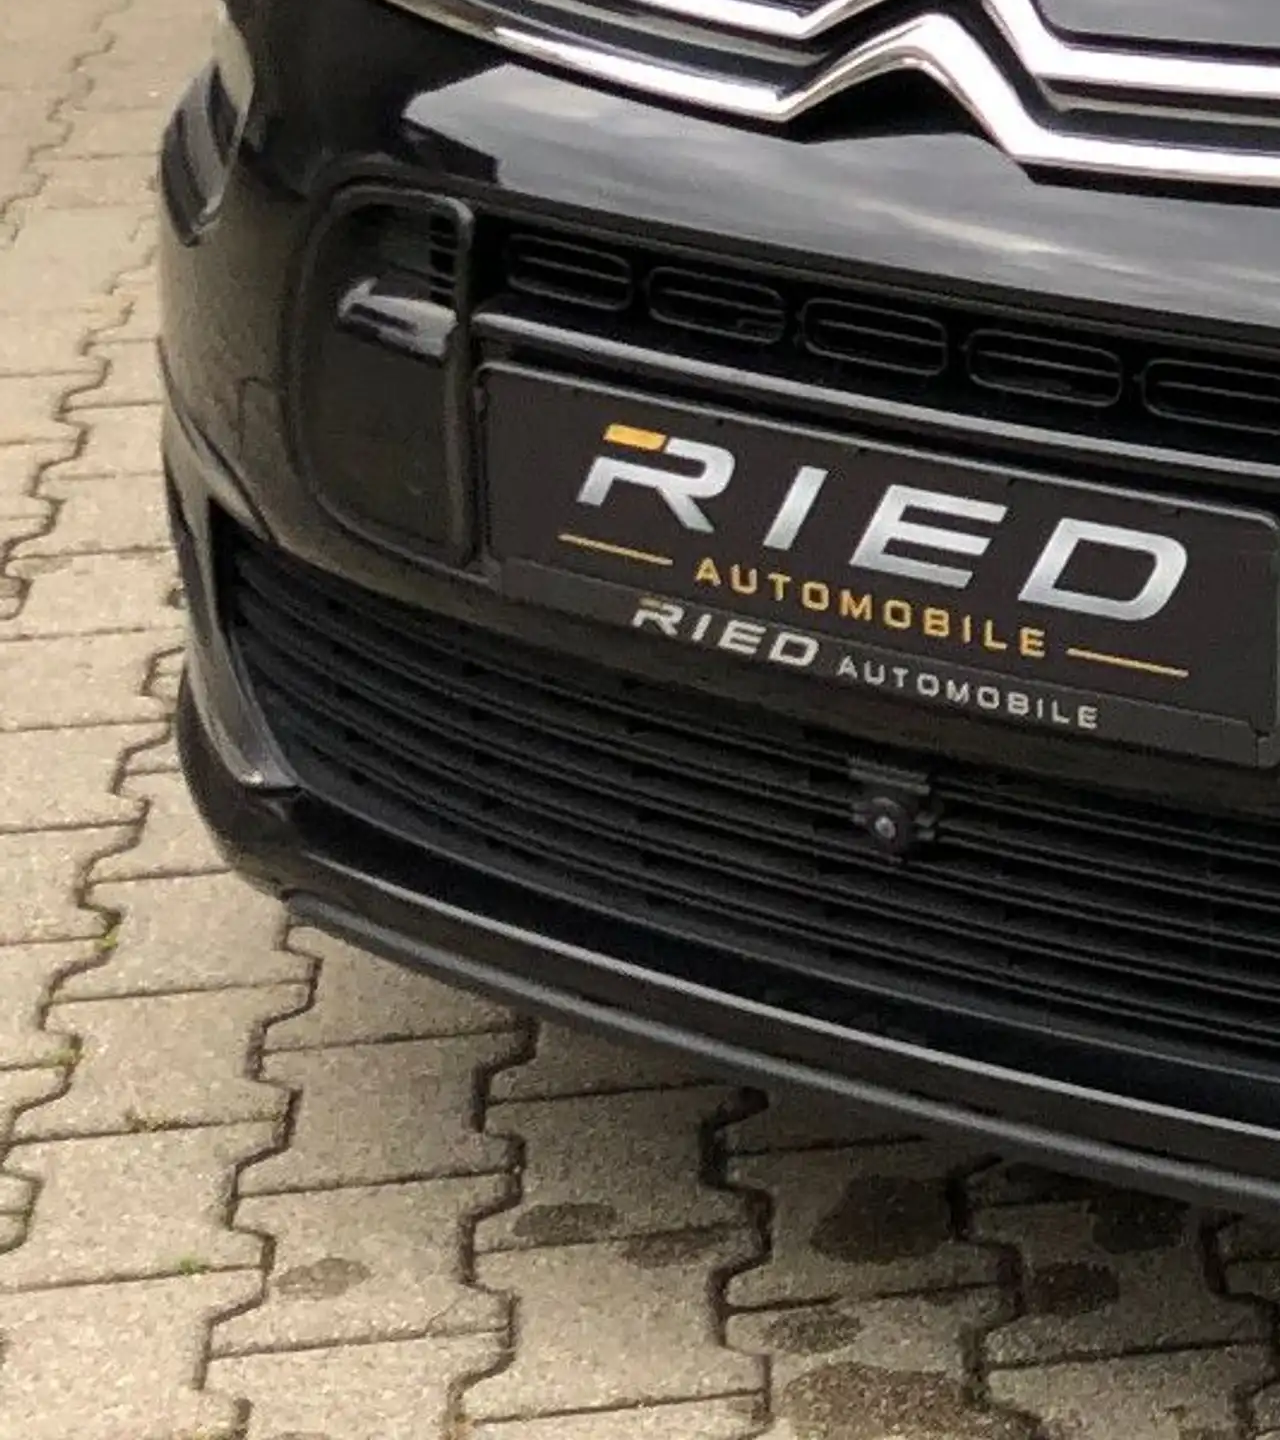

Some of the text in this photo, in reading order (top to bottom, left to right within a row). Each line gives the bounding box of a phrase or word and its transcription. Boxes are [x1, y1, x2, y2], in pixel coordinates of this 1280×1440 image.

[576, 424, 1188, 621] RIED
[632, 598, 1099, 730] RIED AUTOMOBILE
[694, 558, 1047, 658] AUTOMOBILE
